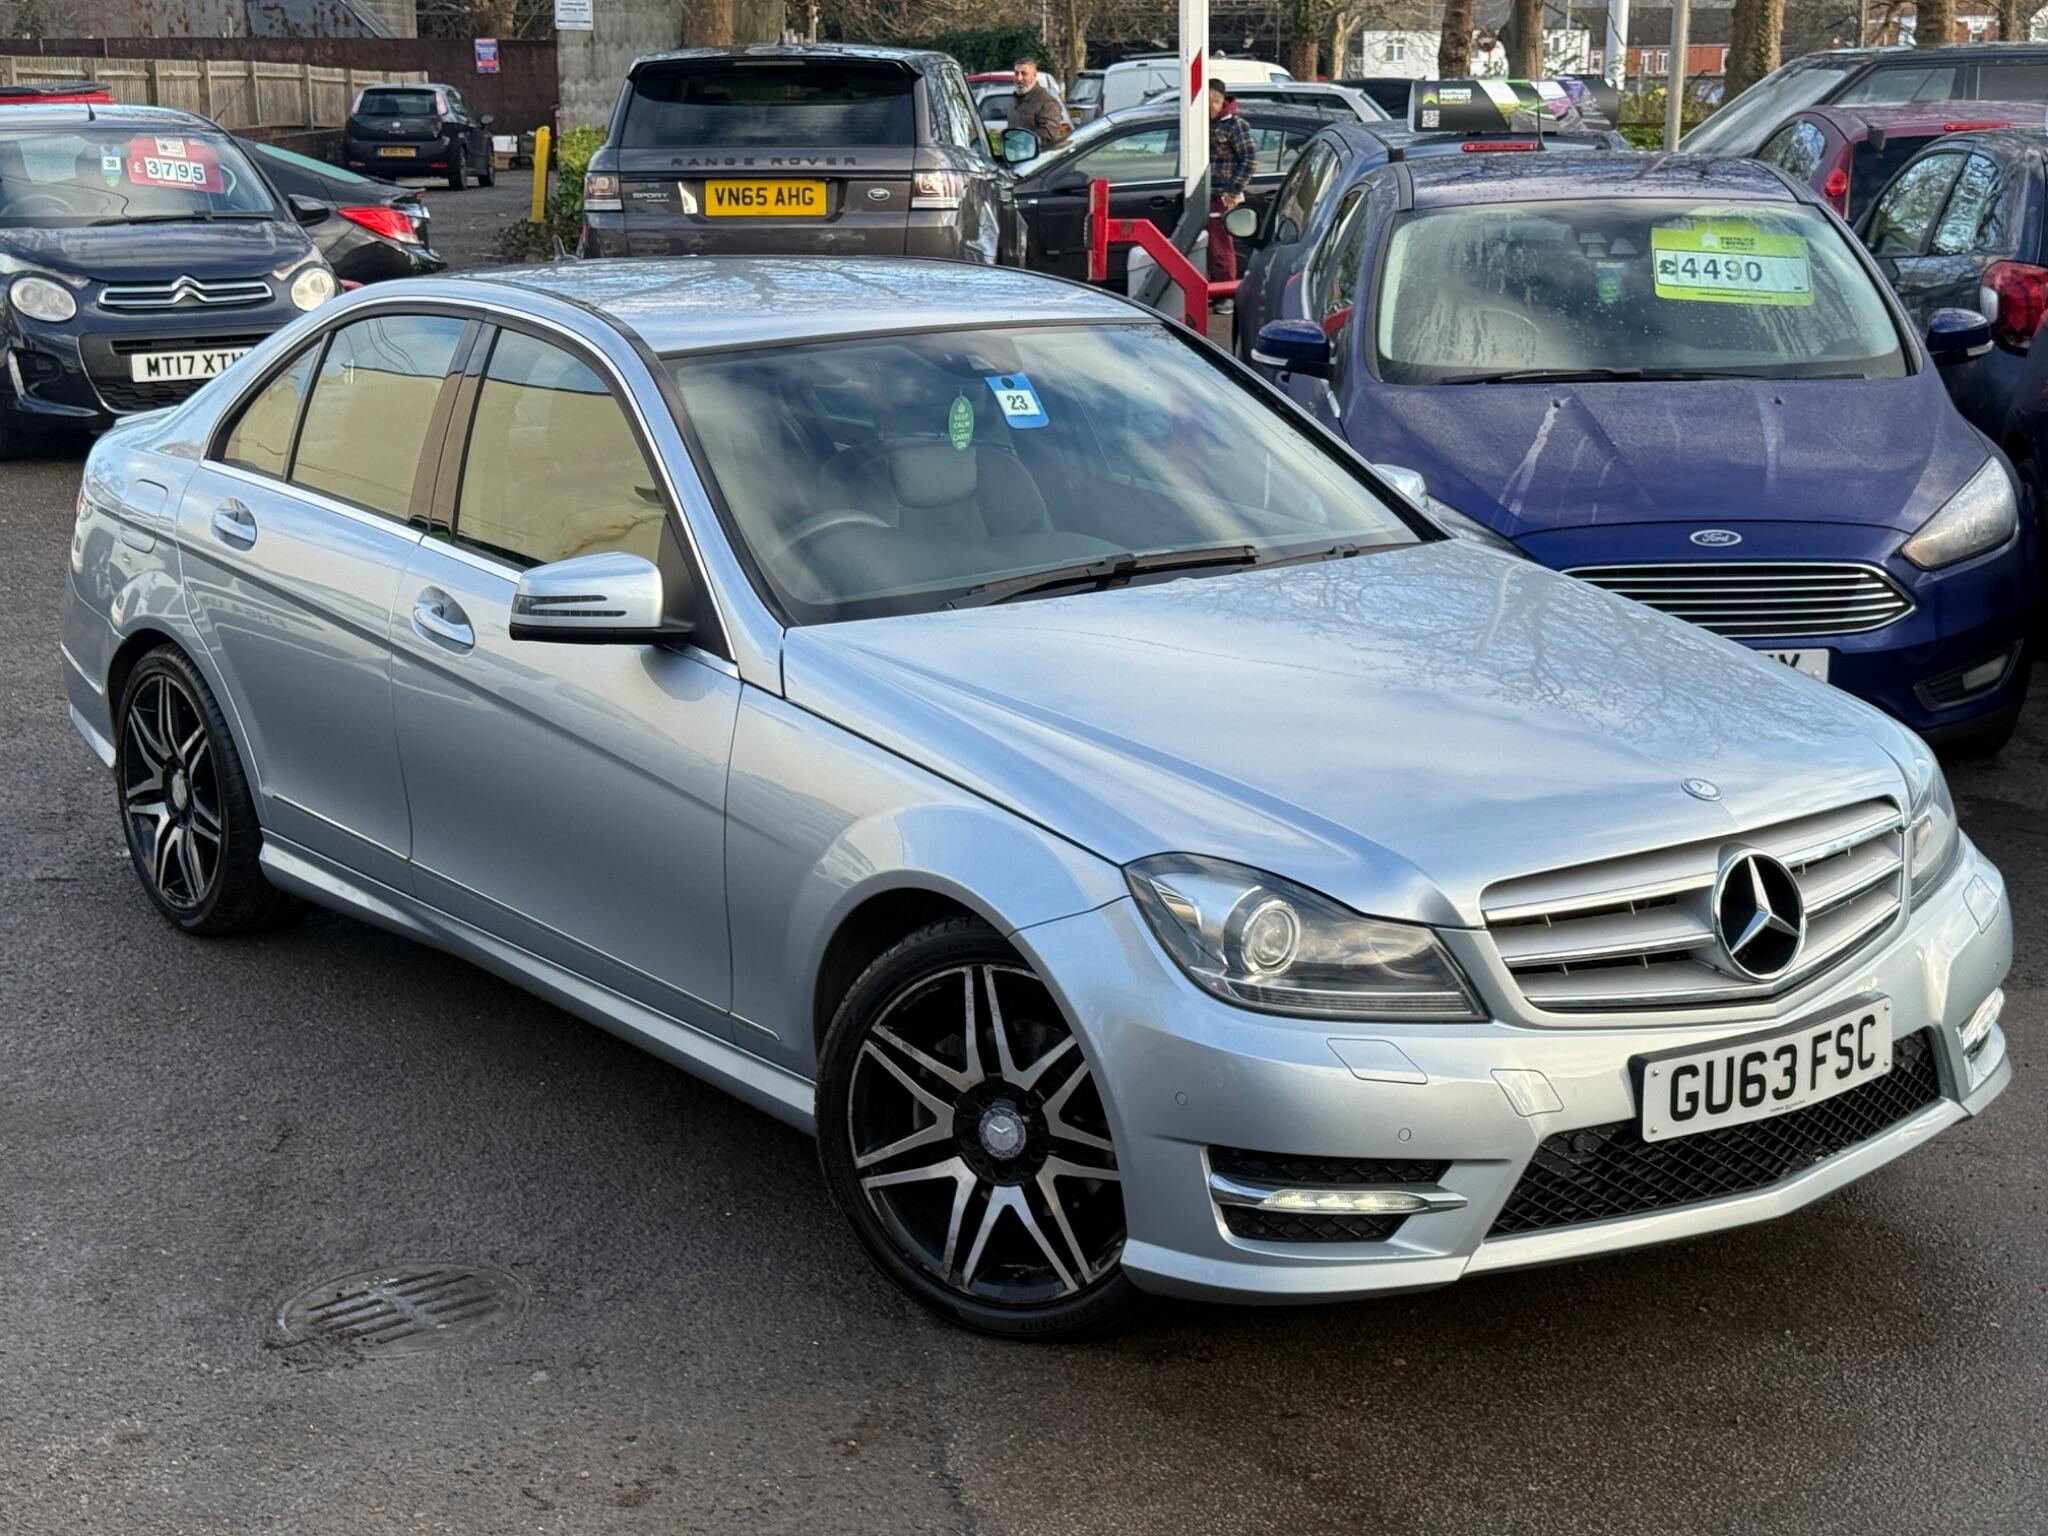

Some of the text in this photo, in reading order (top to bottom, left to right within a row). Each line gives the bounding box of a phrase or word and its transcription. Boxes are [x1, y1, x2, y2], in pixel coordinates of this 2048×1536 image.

[671, 157, 857, 166] RANGE ROVER
[714, 187, 814, 207] VN65 AHG
[1658, 257, 1763, 282] £4490
[146, 355, 195, 377] MT17
[1006, 395, 1029, 410] 23
[953, 421, 970, 429] CALM
[952, 433, 970, 441] CARRY
[957, 441, 967, 449] ON
[1702, 532, 1730, 542] Ford
[1670, 1014, 1876, 1122] GU63 FSC
